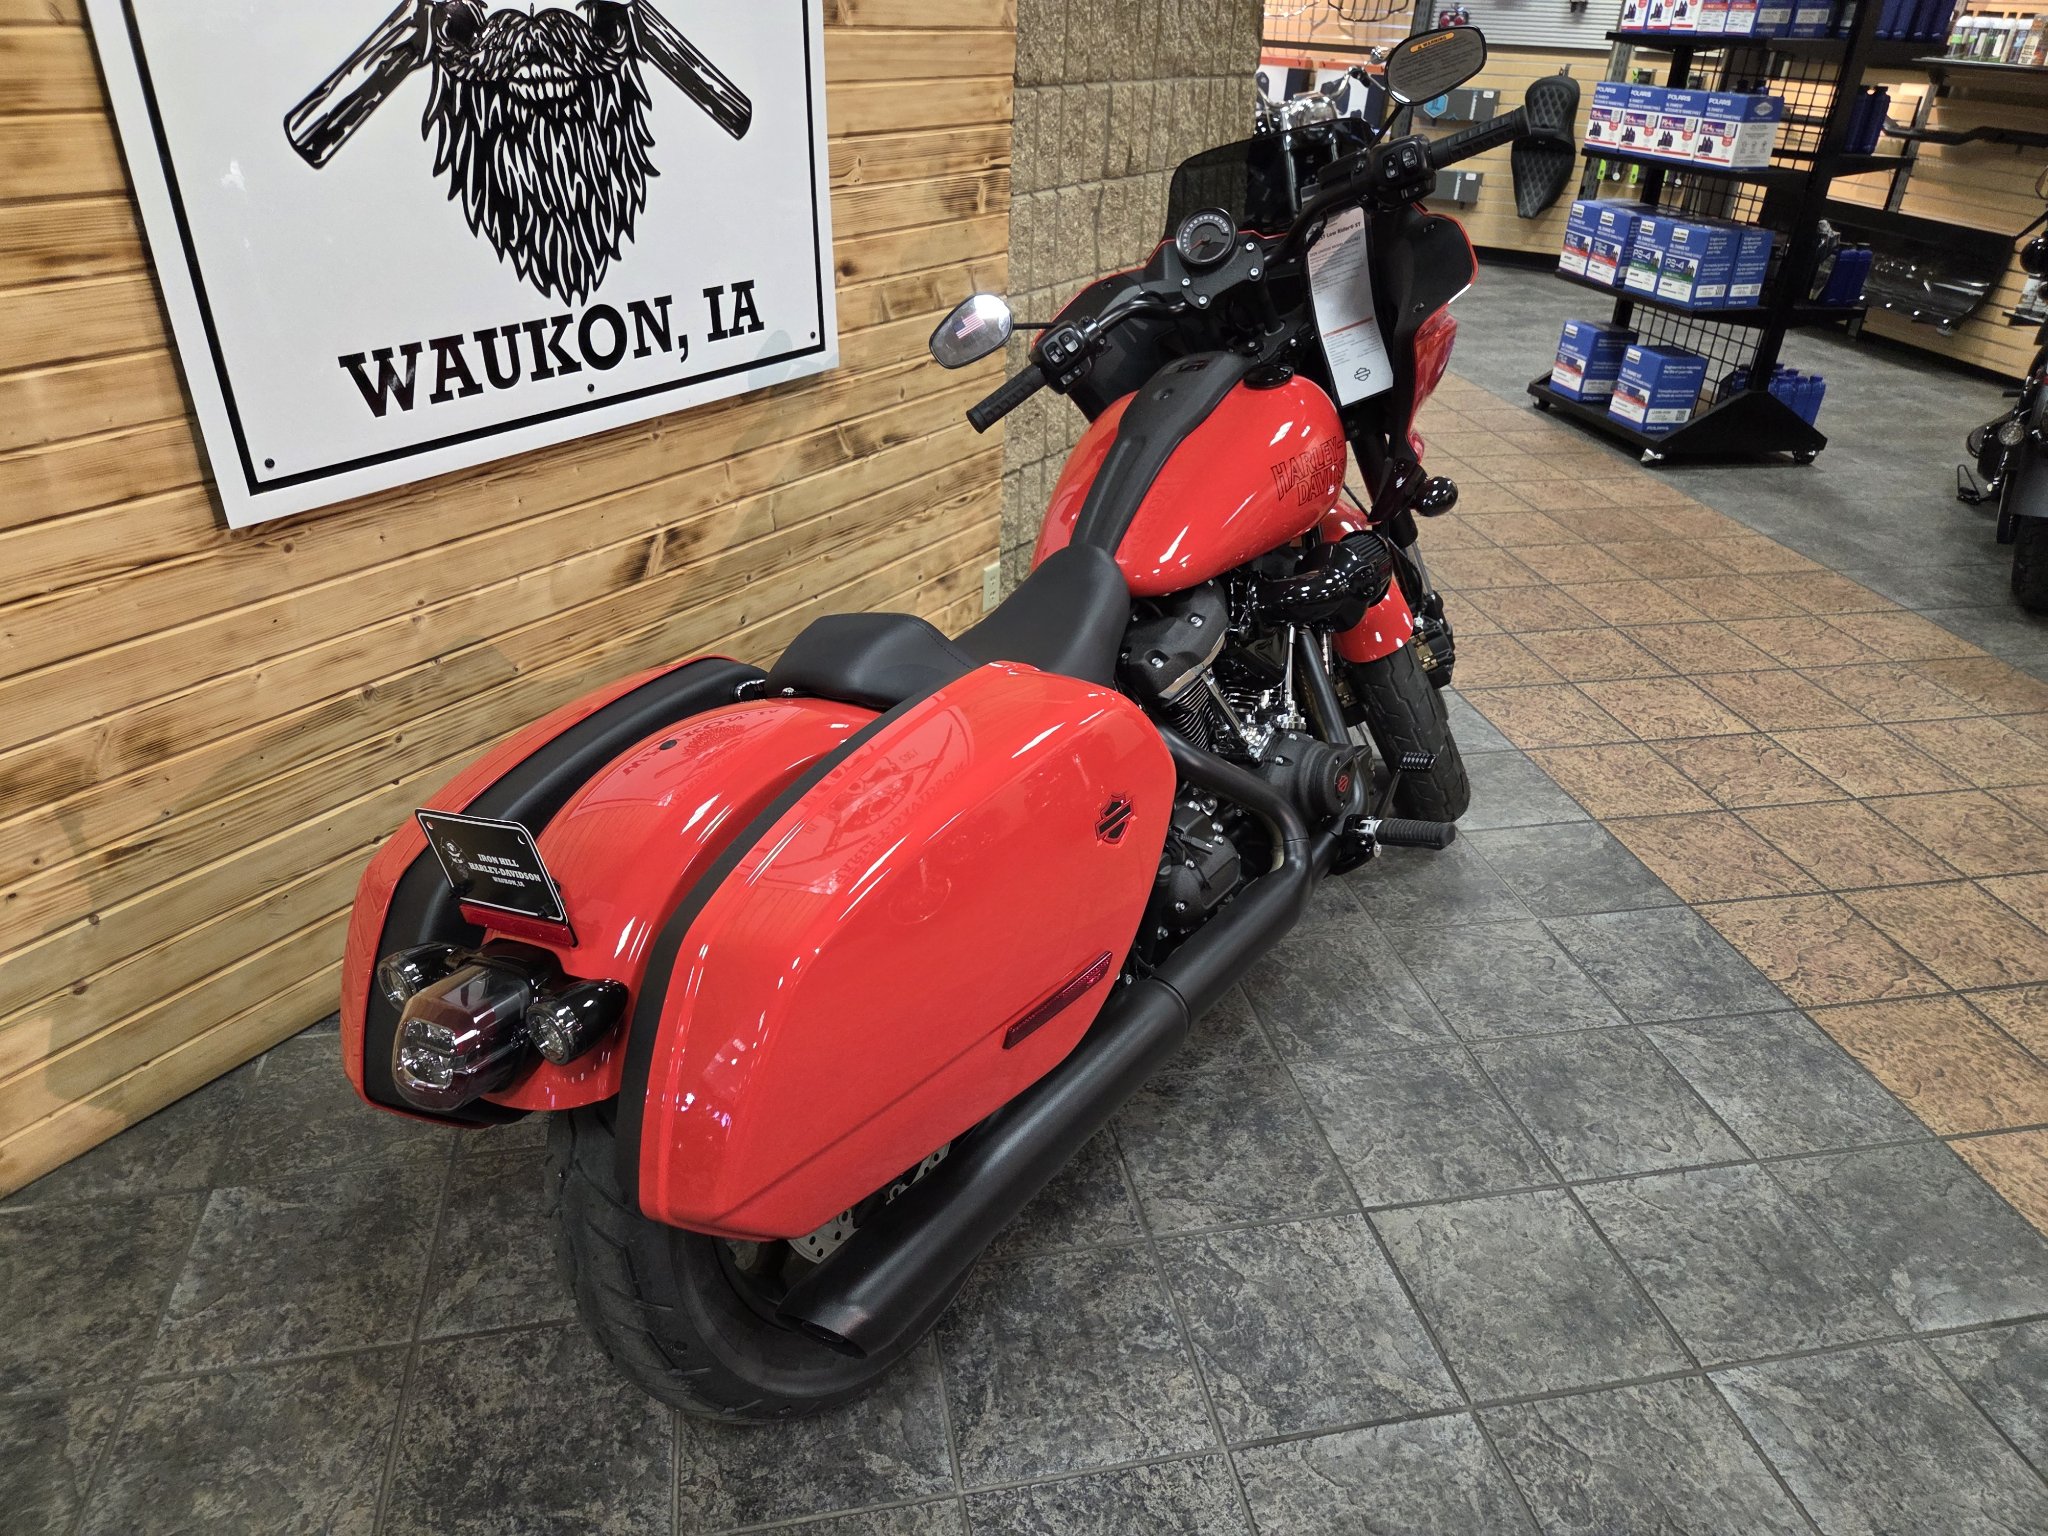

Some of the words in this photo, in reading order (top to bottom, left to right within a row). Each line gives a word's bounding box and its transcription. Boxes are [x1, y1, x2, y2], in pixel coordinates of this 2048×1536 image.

[1423, 35, 1447, 47] WARNING
[1667, 93, 1692, 102] POLARIS
[1708, 97, 1732, 106] POLARIS
[1326, 230, 1337, 238] Low
[1632, 248, 1652, 261] PS-4
[1664, 257, 1685, 270] PS-4
[338, 294, 688, 419] WAUKON,
[702, 279, 765, 342] IA
[1270, 435, 1344, 502] HARLEY-
[477, 853, 500, 865] IRON
[500, 857, 520, 868] HILL
[468, 861, 542, 883] HARLEY-DAVIDSON
